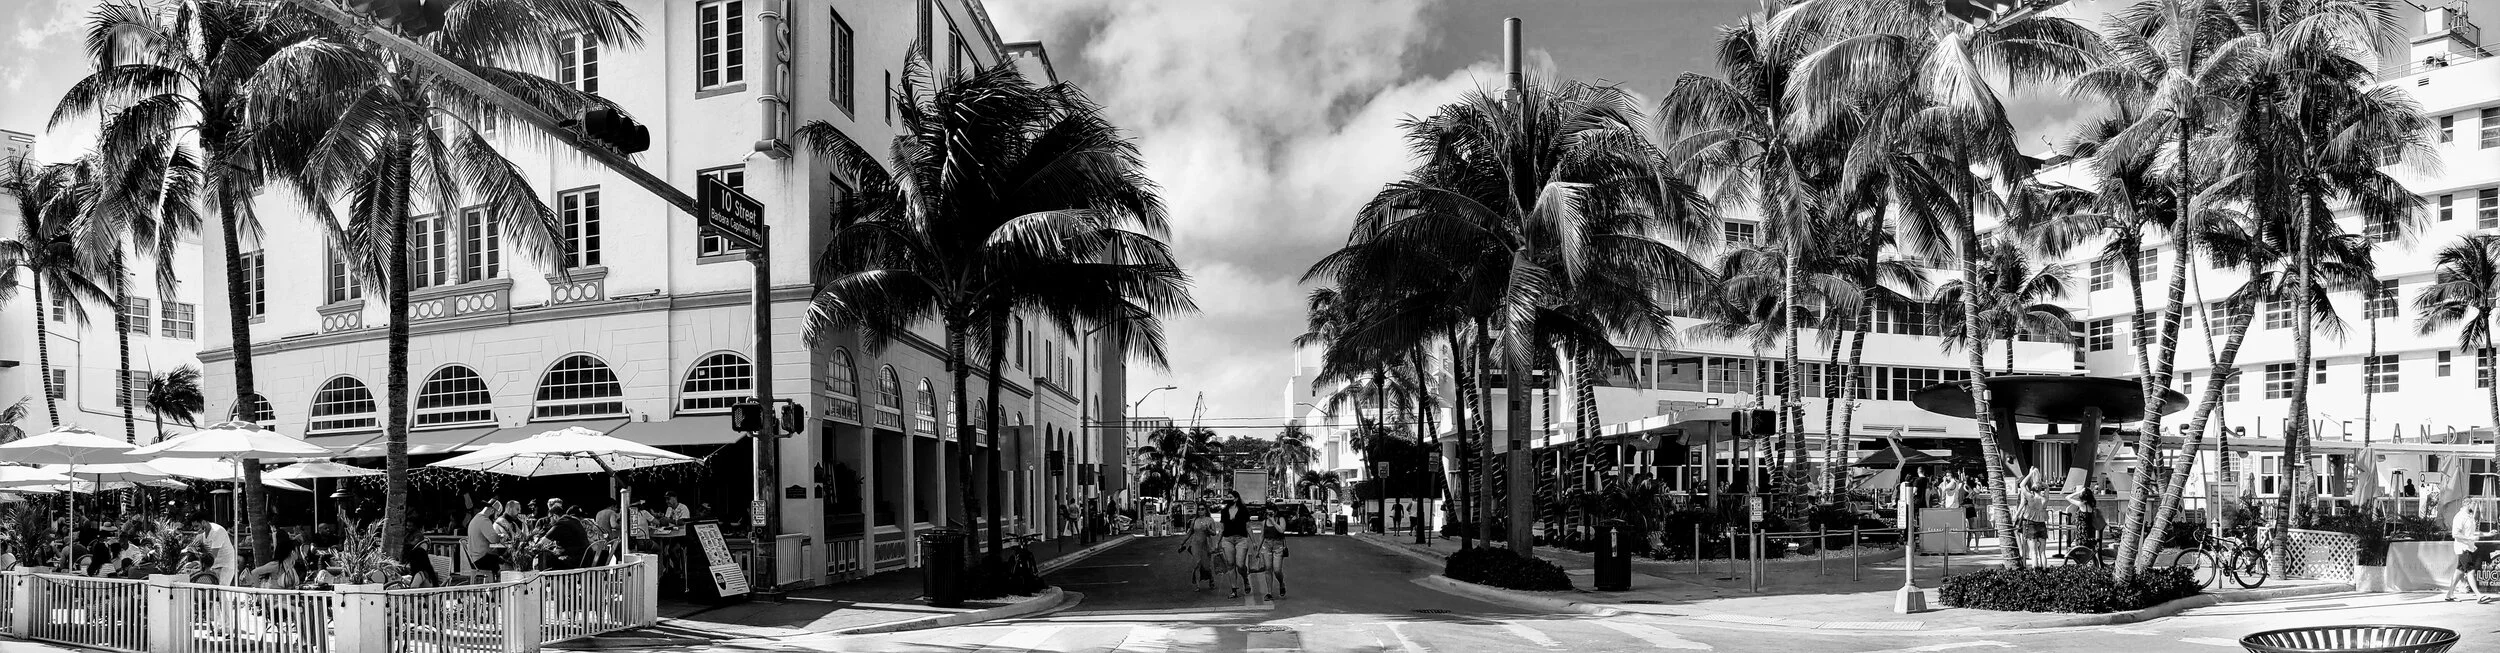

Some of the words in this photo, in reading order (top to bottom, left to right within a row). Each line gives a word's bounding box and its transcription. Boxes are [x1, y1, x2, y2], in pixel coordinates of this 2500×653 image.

[711, 207, 729, 226] Barbara
[730, 217, 751, 237] Capitman
[751, 227, 762, 243] Way
[721, 189, 732, 212] 10
[734, 200, 757, 225] Street
